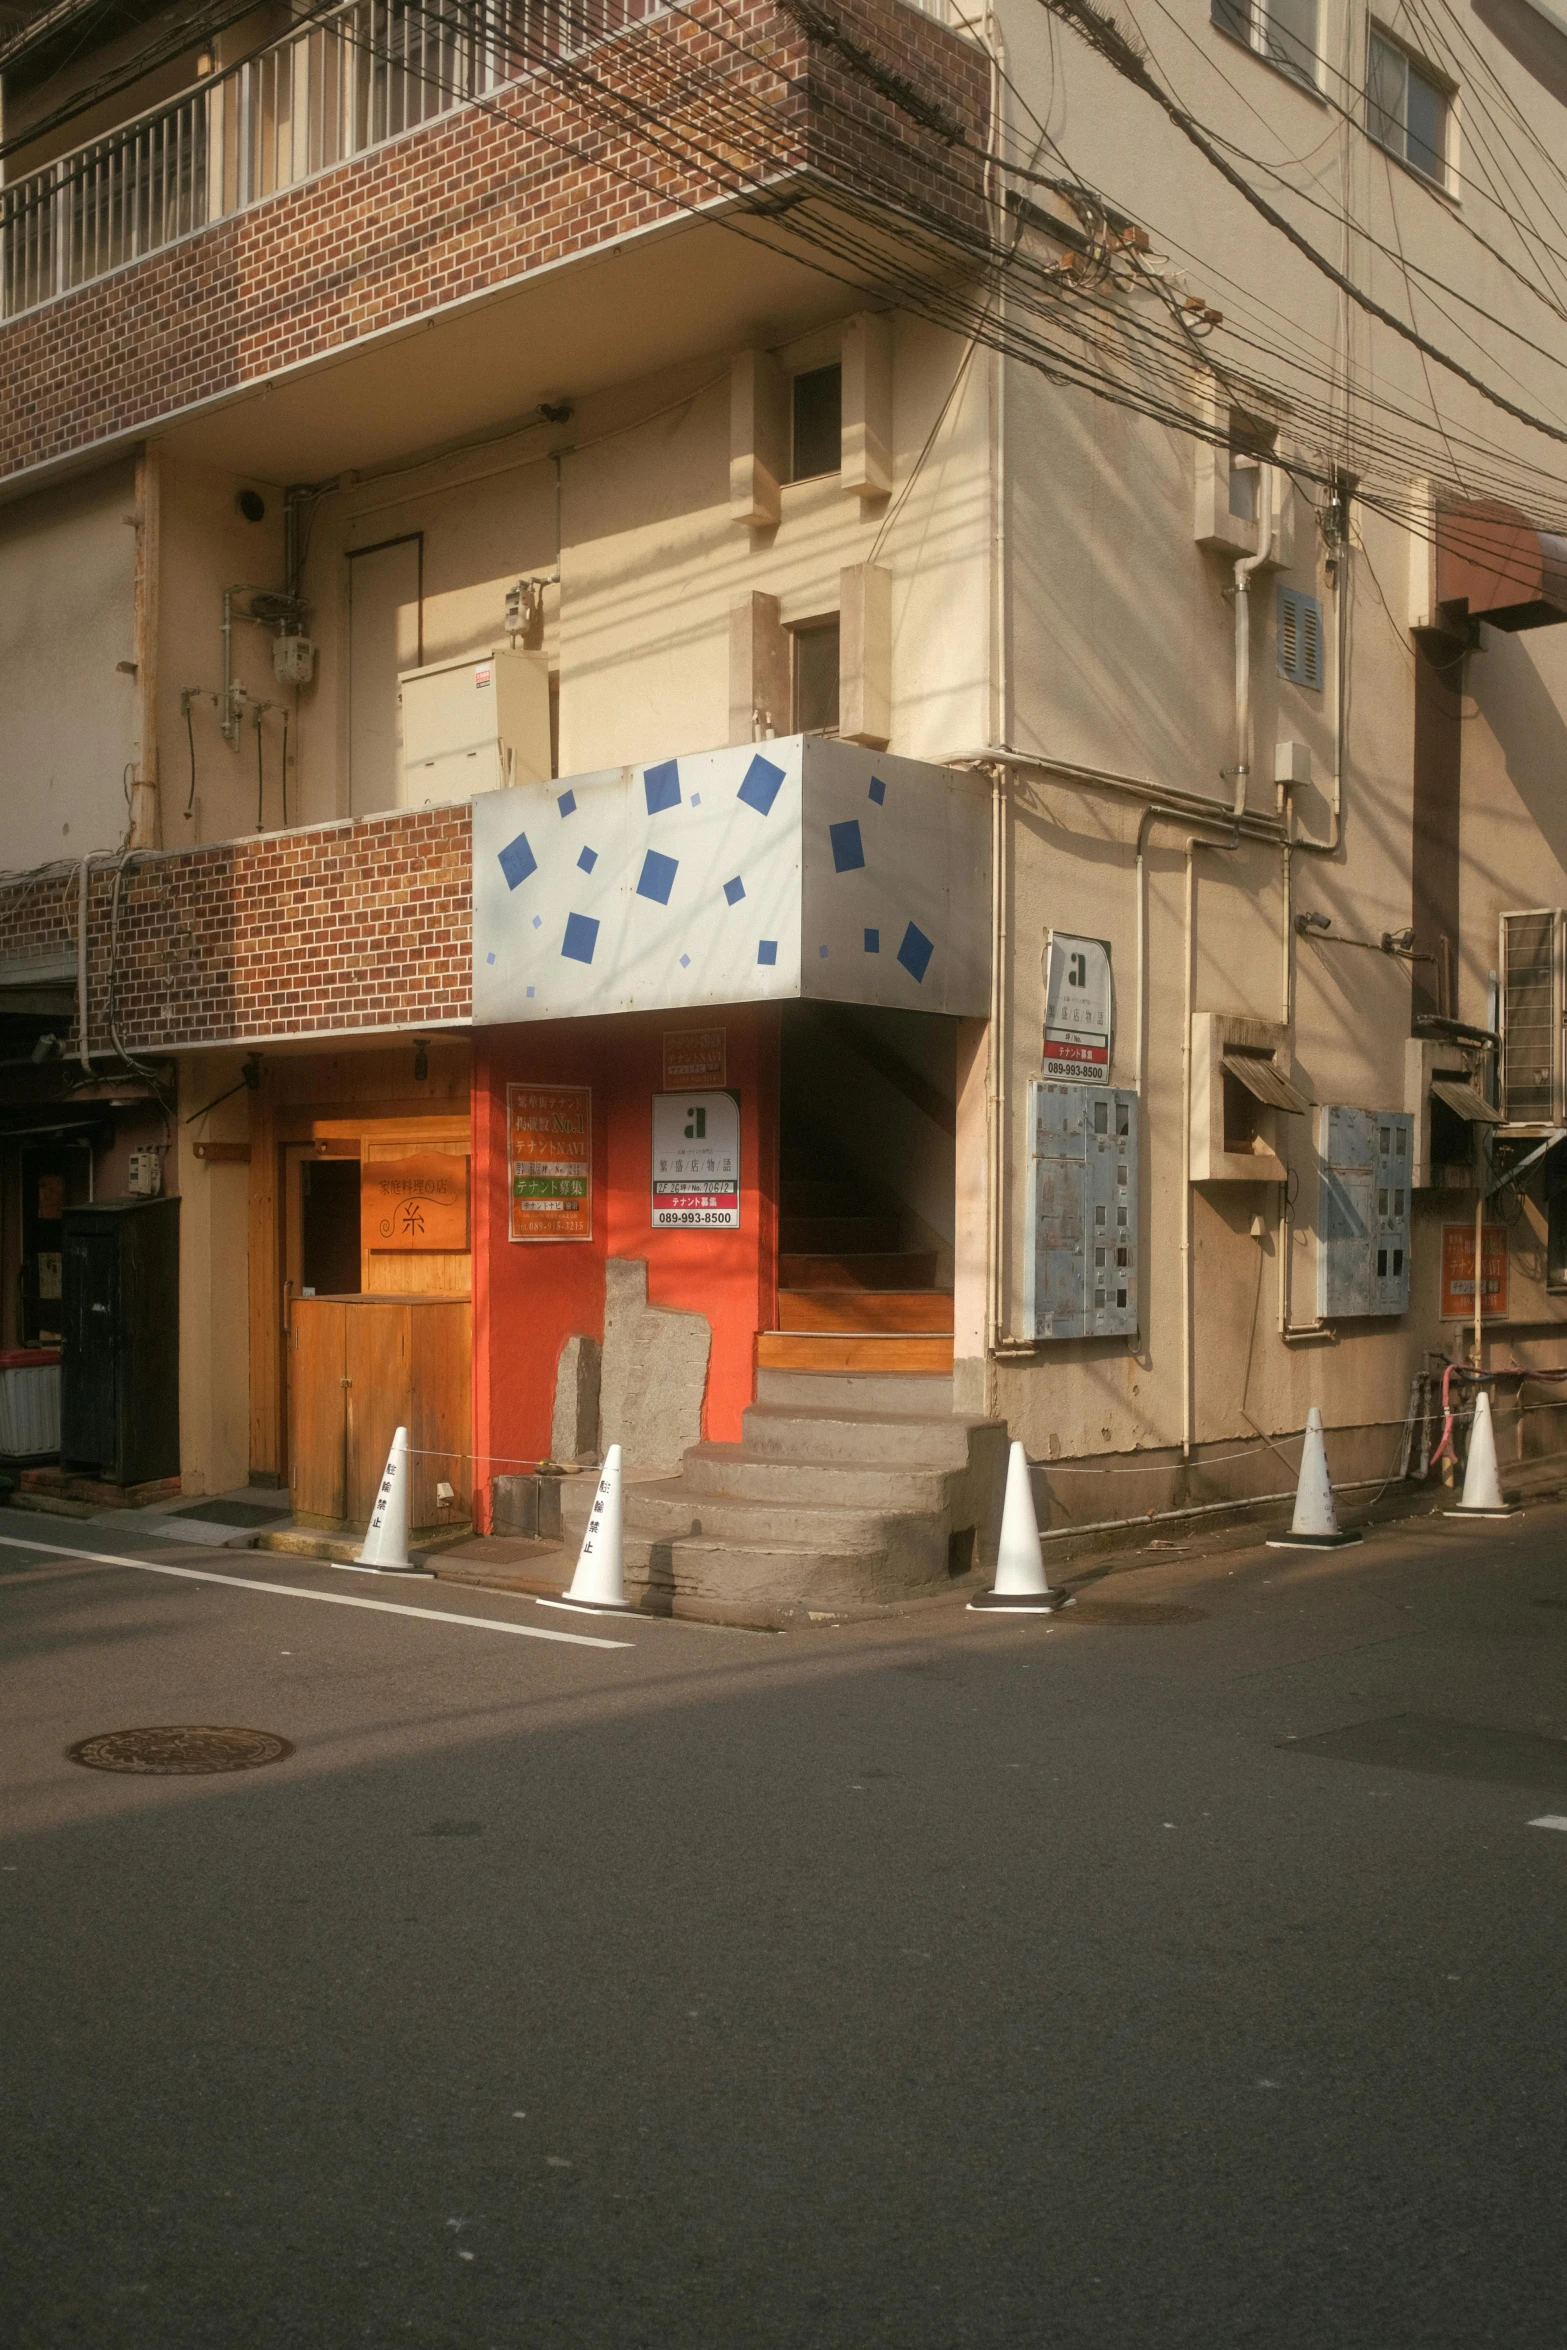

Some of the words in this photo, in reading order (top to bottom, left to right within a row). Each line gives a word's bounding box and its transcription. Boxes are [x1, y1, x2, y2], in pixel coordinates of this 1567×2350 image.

[1058, 1046, 1093, 1060] テナント募集
[1048, 1062, 1103, 1079] 089-993-8500
[552, 1112, 585, 1134] No.1
[515, 1139, 586, 1157] テナントNAVI
[379, 1178, 449, 1195] 家庭料理の店
[517, 1180, 583, 1196] テナント募集
[672, 1197, 717, 1207] テナント募集
[401, 1201, 425, 1236] 糸
[529, 1221, 584, 1231] 089-915-3215
[659, 1212, 731, 1224] 089-993-8500
[372, 1463, 397, 1529] 駐輪禁止
[583, 1479, 611, 1554] 駐輪禁止
